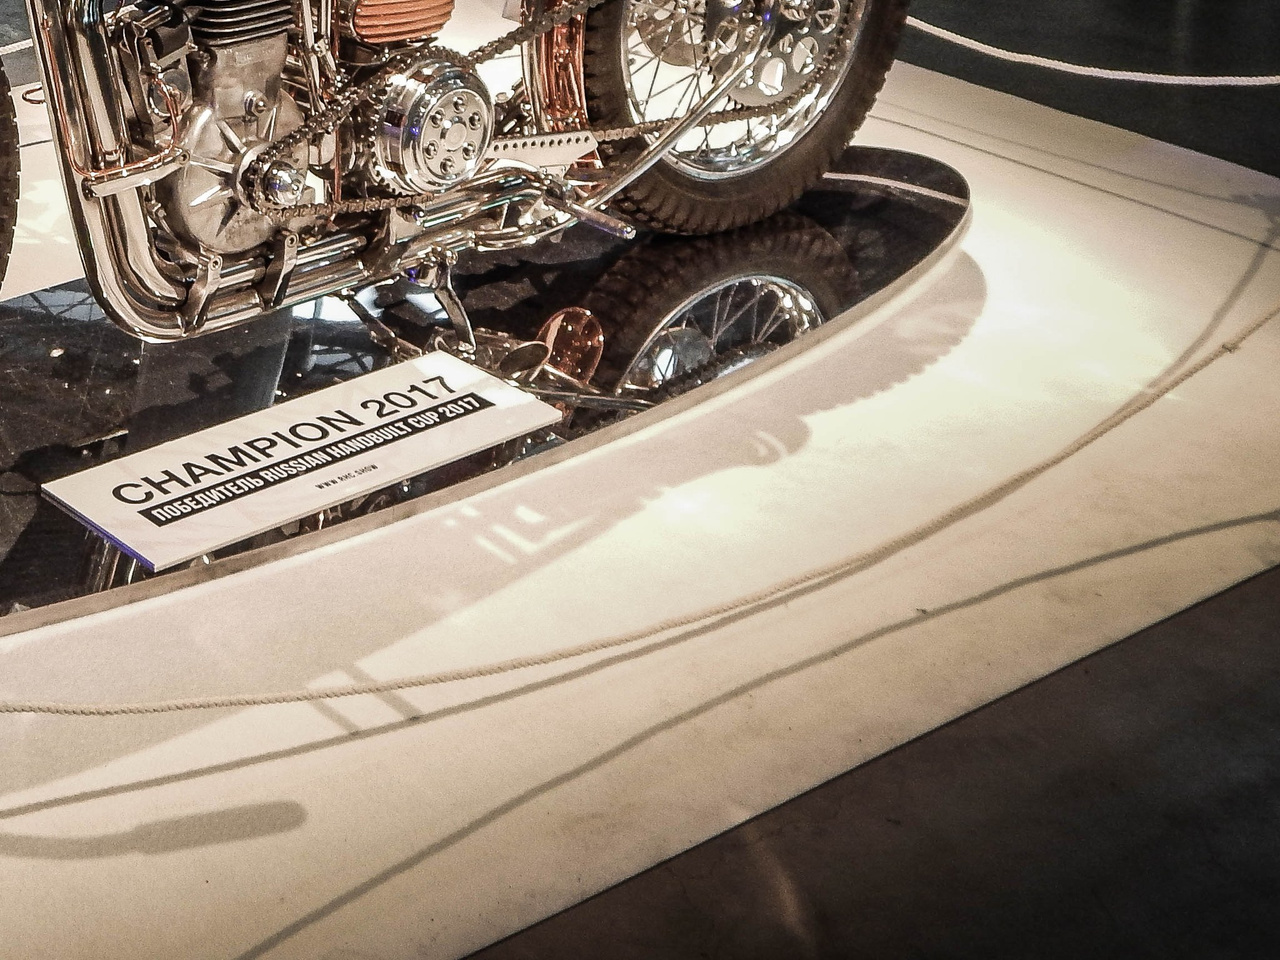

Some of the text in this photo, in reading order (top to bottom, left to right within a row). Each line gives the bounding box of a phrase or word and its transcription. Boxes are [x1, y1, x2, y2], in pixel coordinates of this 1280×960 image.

[112, 376, 456, 504] CHAMPION 2017
[151, 396, 482, 522] ПОБЕДИТЕЛЬ RUSSIAN HANDBUILT CUP 2017
